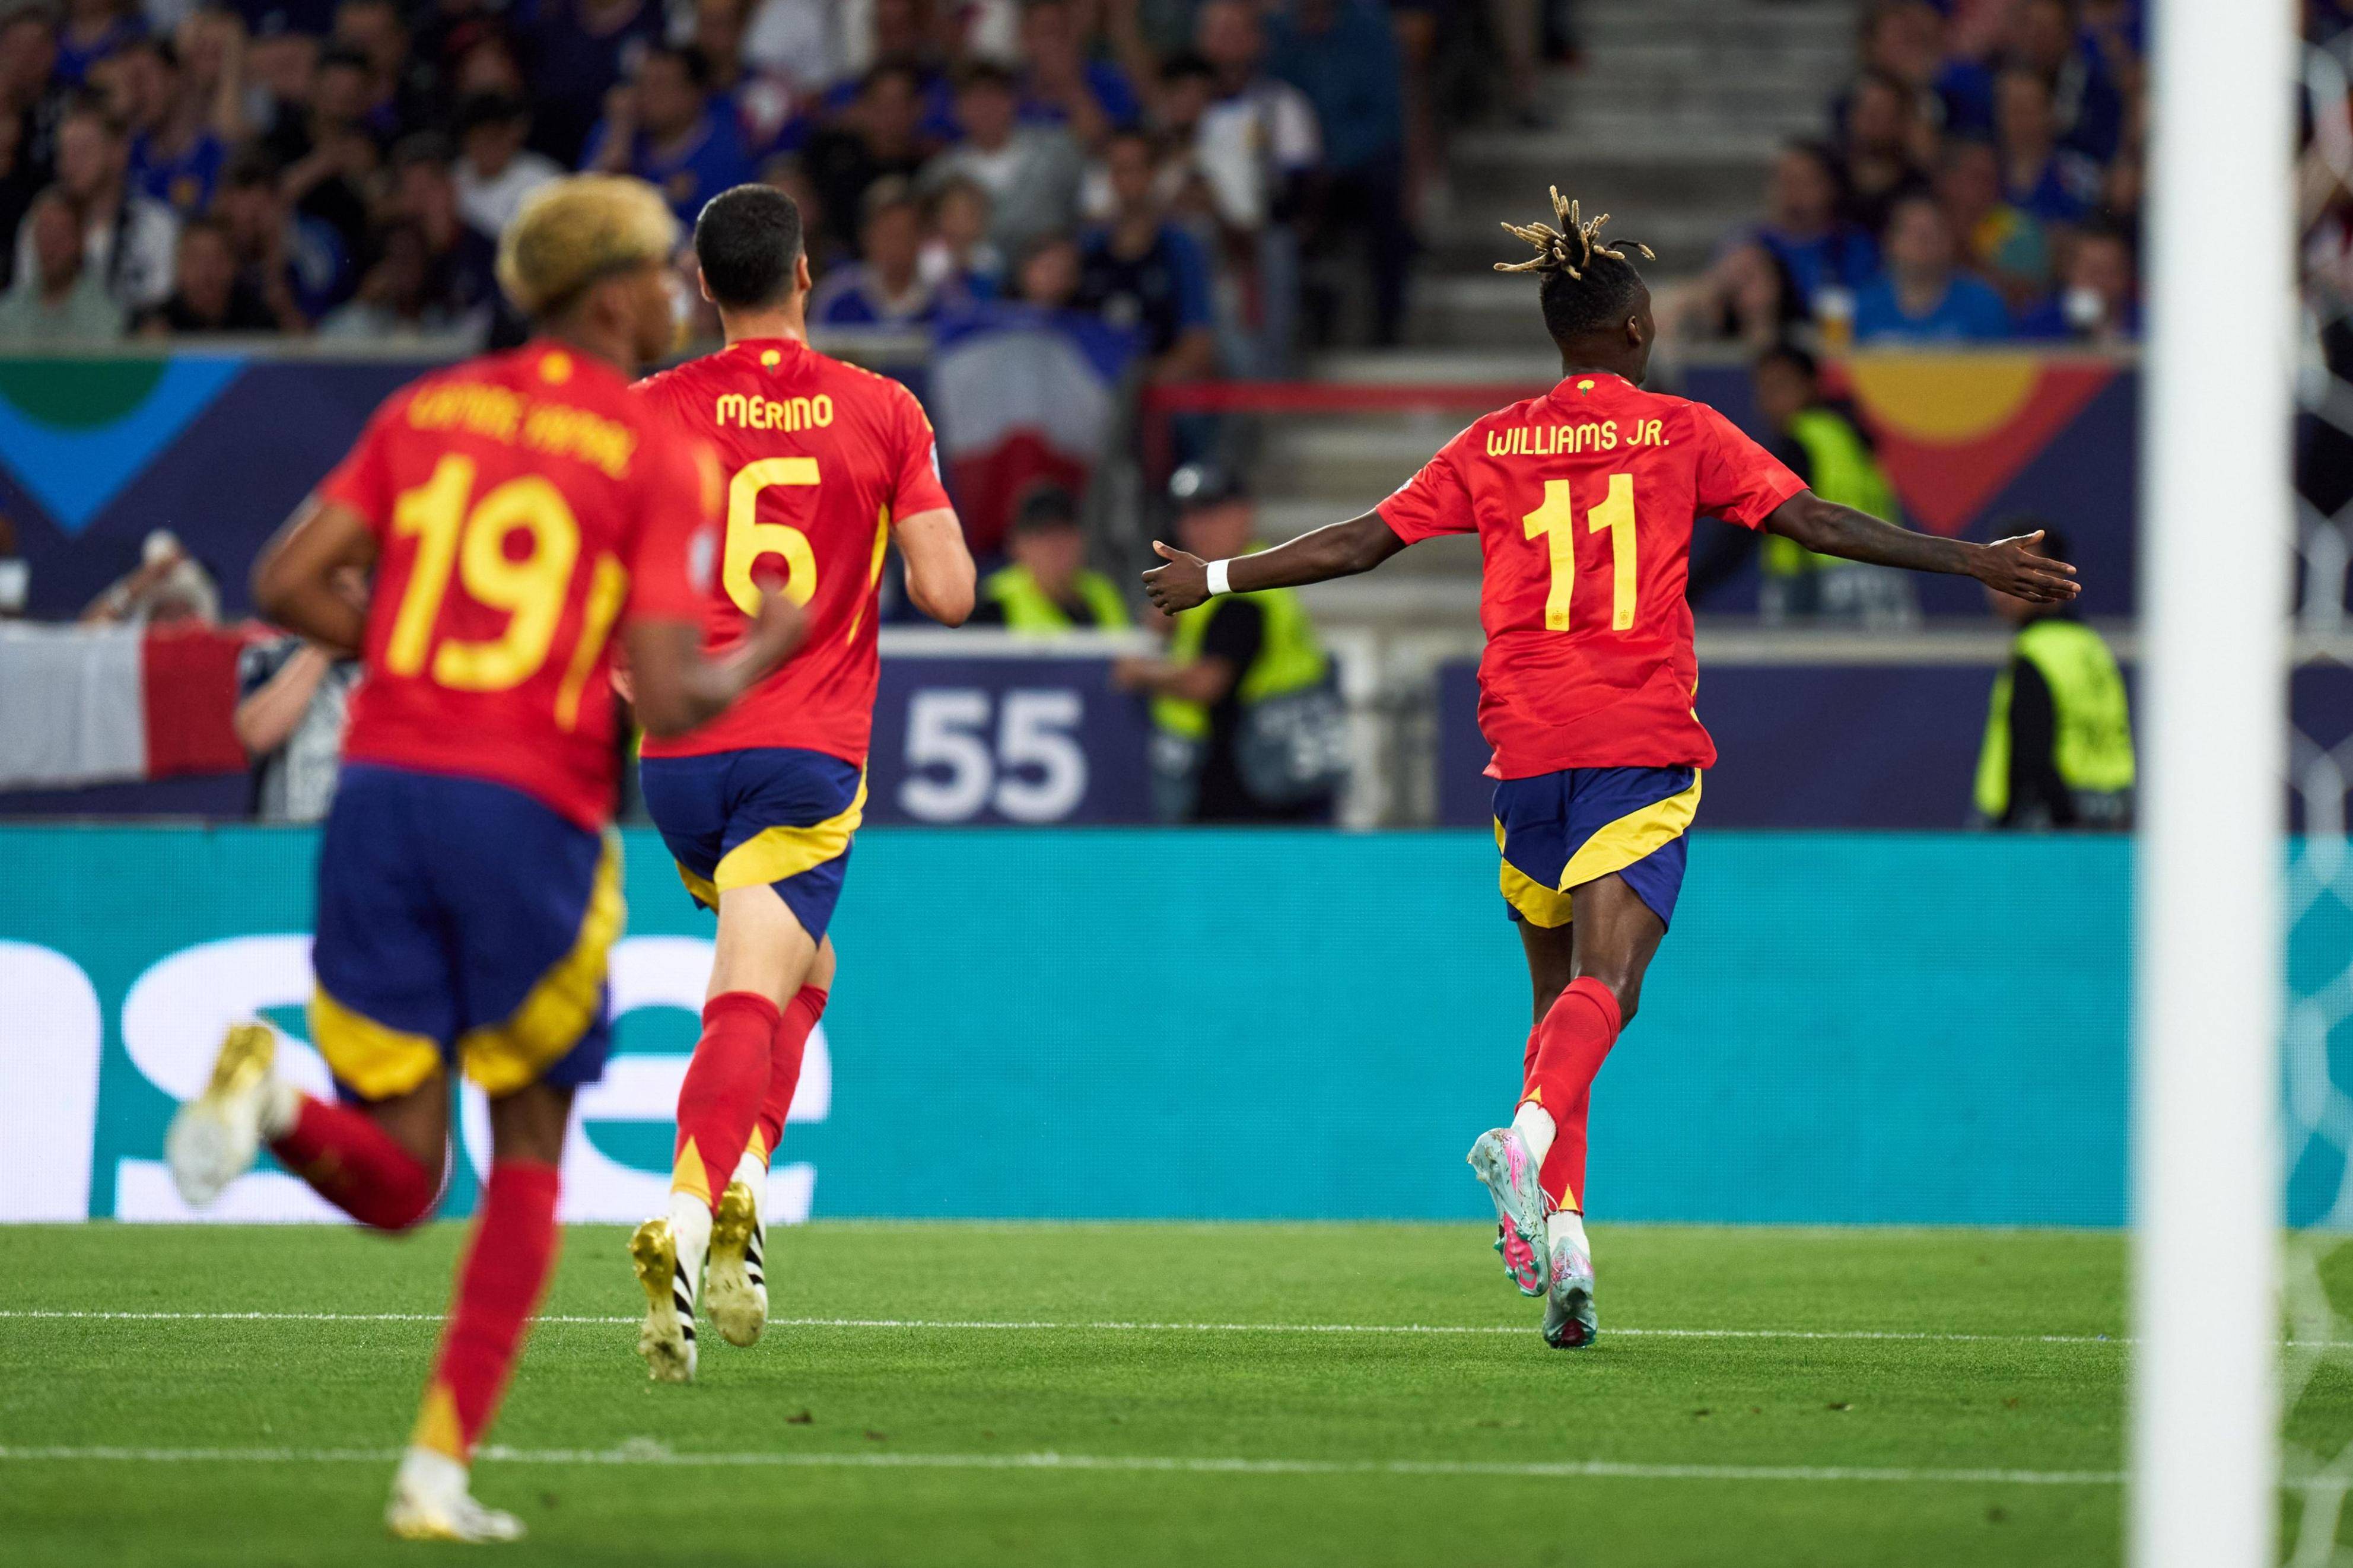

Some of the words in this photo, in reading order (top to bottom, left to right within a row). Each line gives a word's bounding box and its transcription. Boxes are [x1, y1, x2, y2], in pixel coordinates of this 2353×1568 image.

[716, 393, 834, 432] MERINO
[1486, 420, 1618, 457] WILLIAMS
[1626, 419, 1670, 446] JR.
[386, 453, 580, 690] 19
[723, 457, 821, 618] 6
[1522, 473, 1637, 632] 11
[900, 690, 1088, 822] 55
